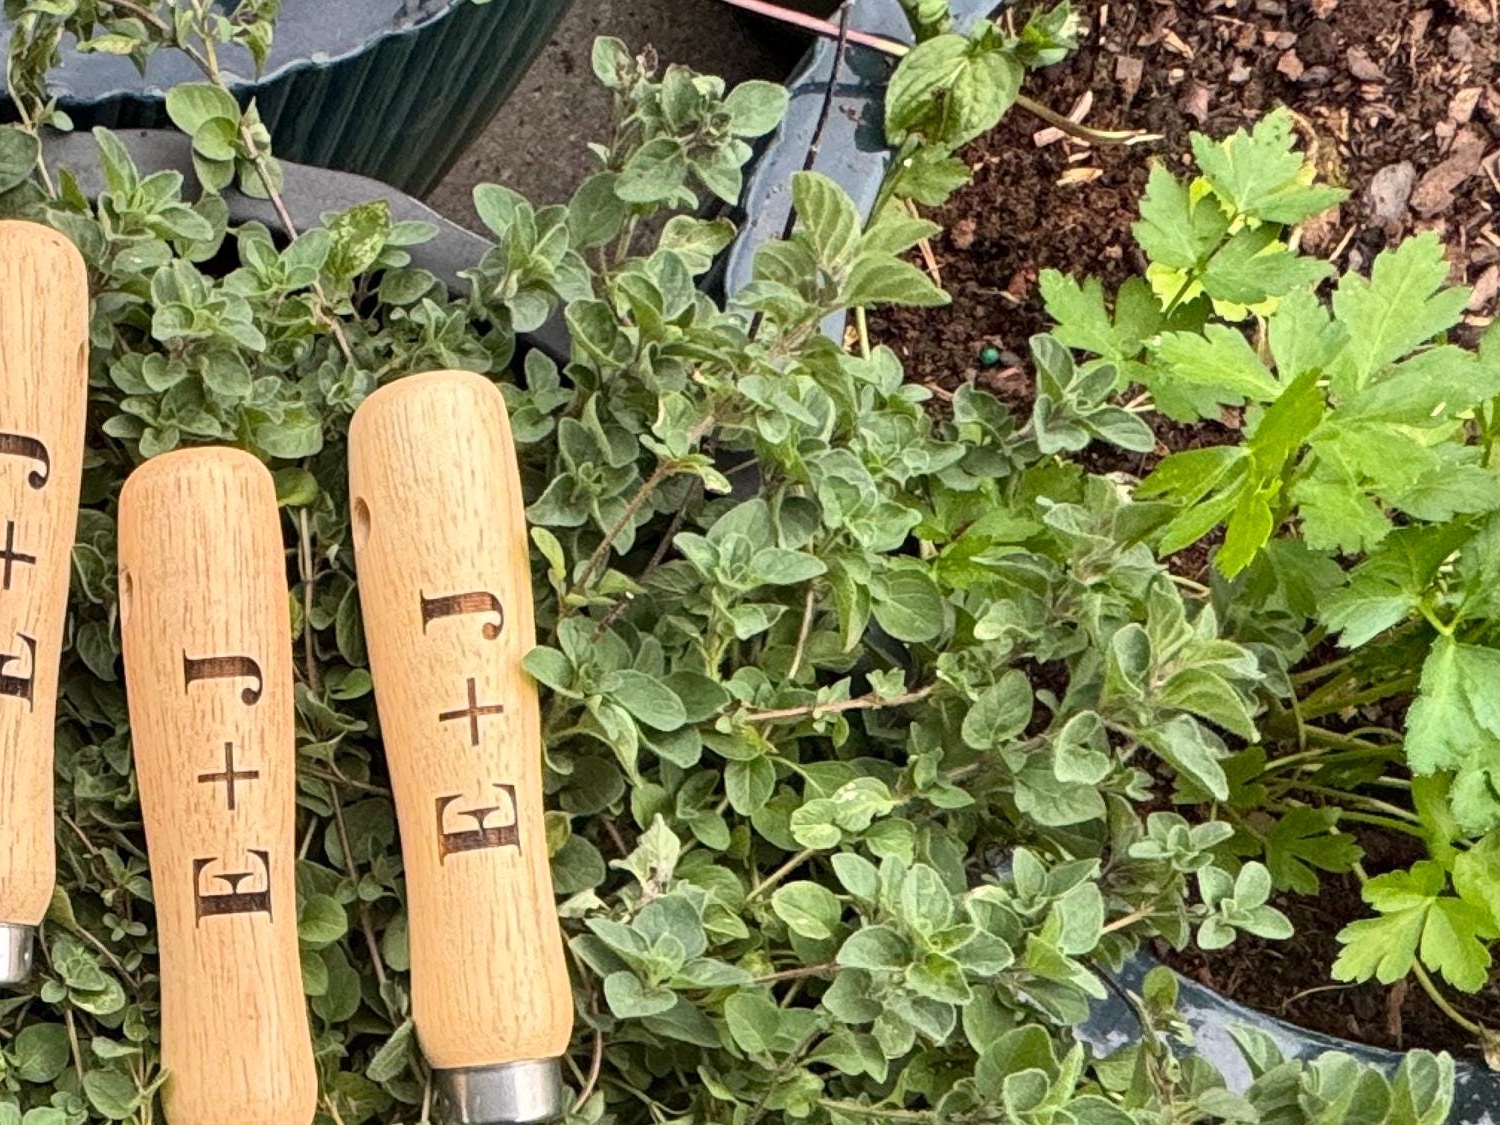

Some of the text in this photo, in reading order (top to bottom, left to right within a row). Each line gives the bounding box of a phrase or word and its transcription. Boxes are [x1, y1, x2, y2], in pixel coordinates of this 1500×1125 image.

[420, 588, 505, 641] J
[183, 648, 263, 706] J
[435, 783, 523, 867] E
[192, 849, 273, 929] E
